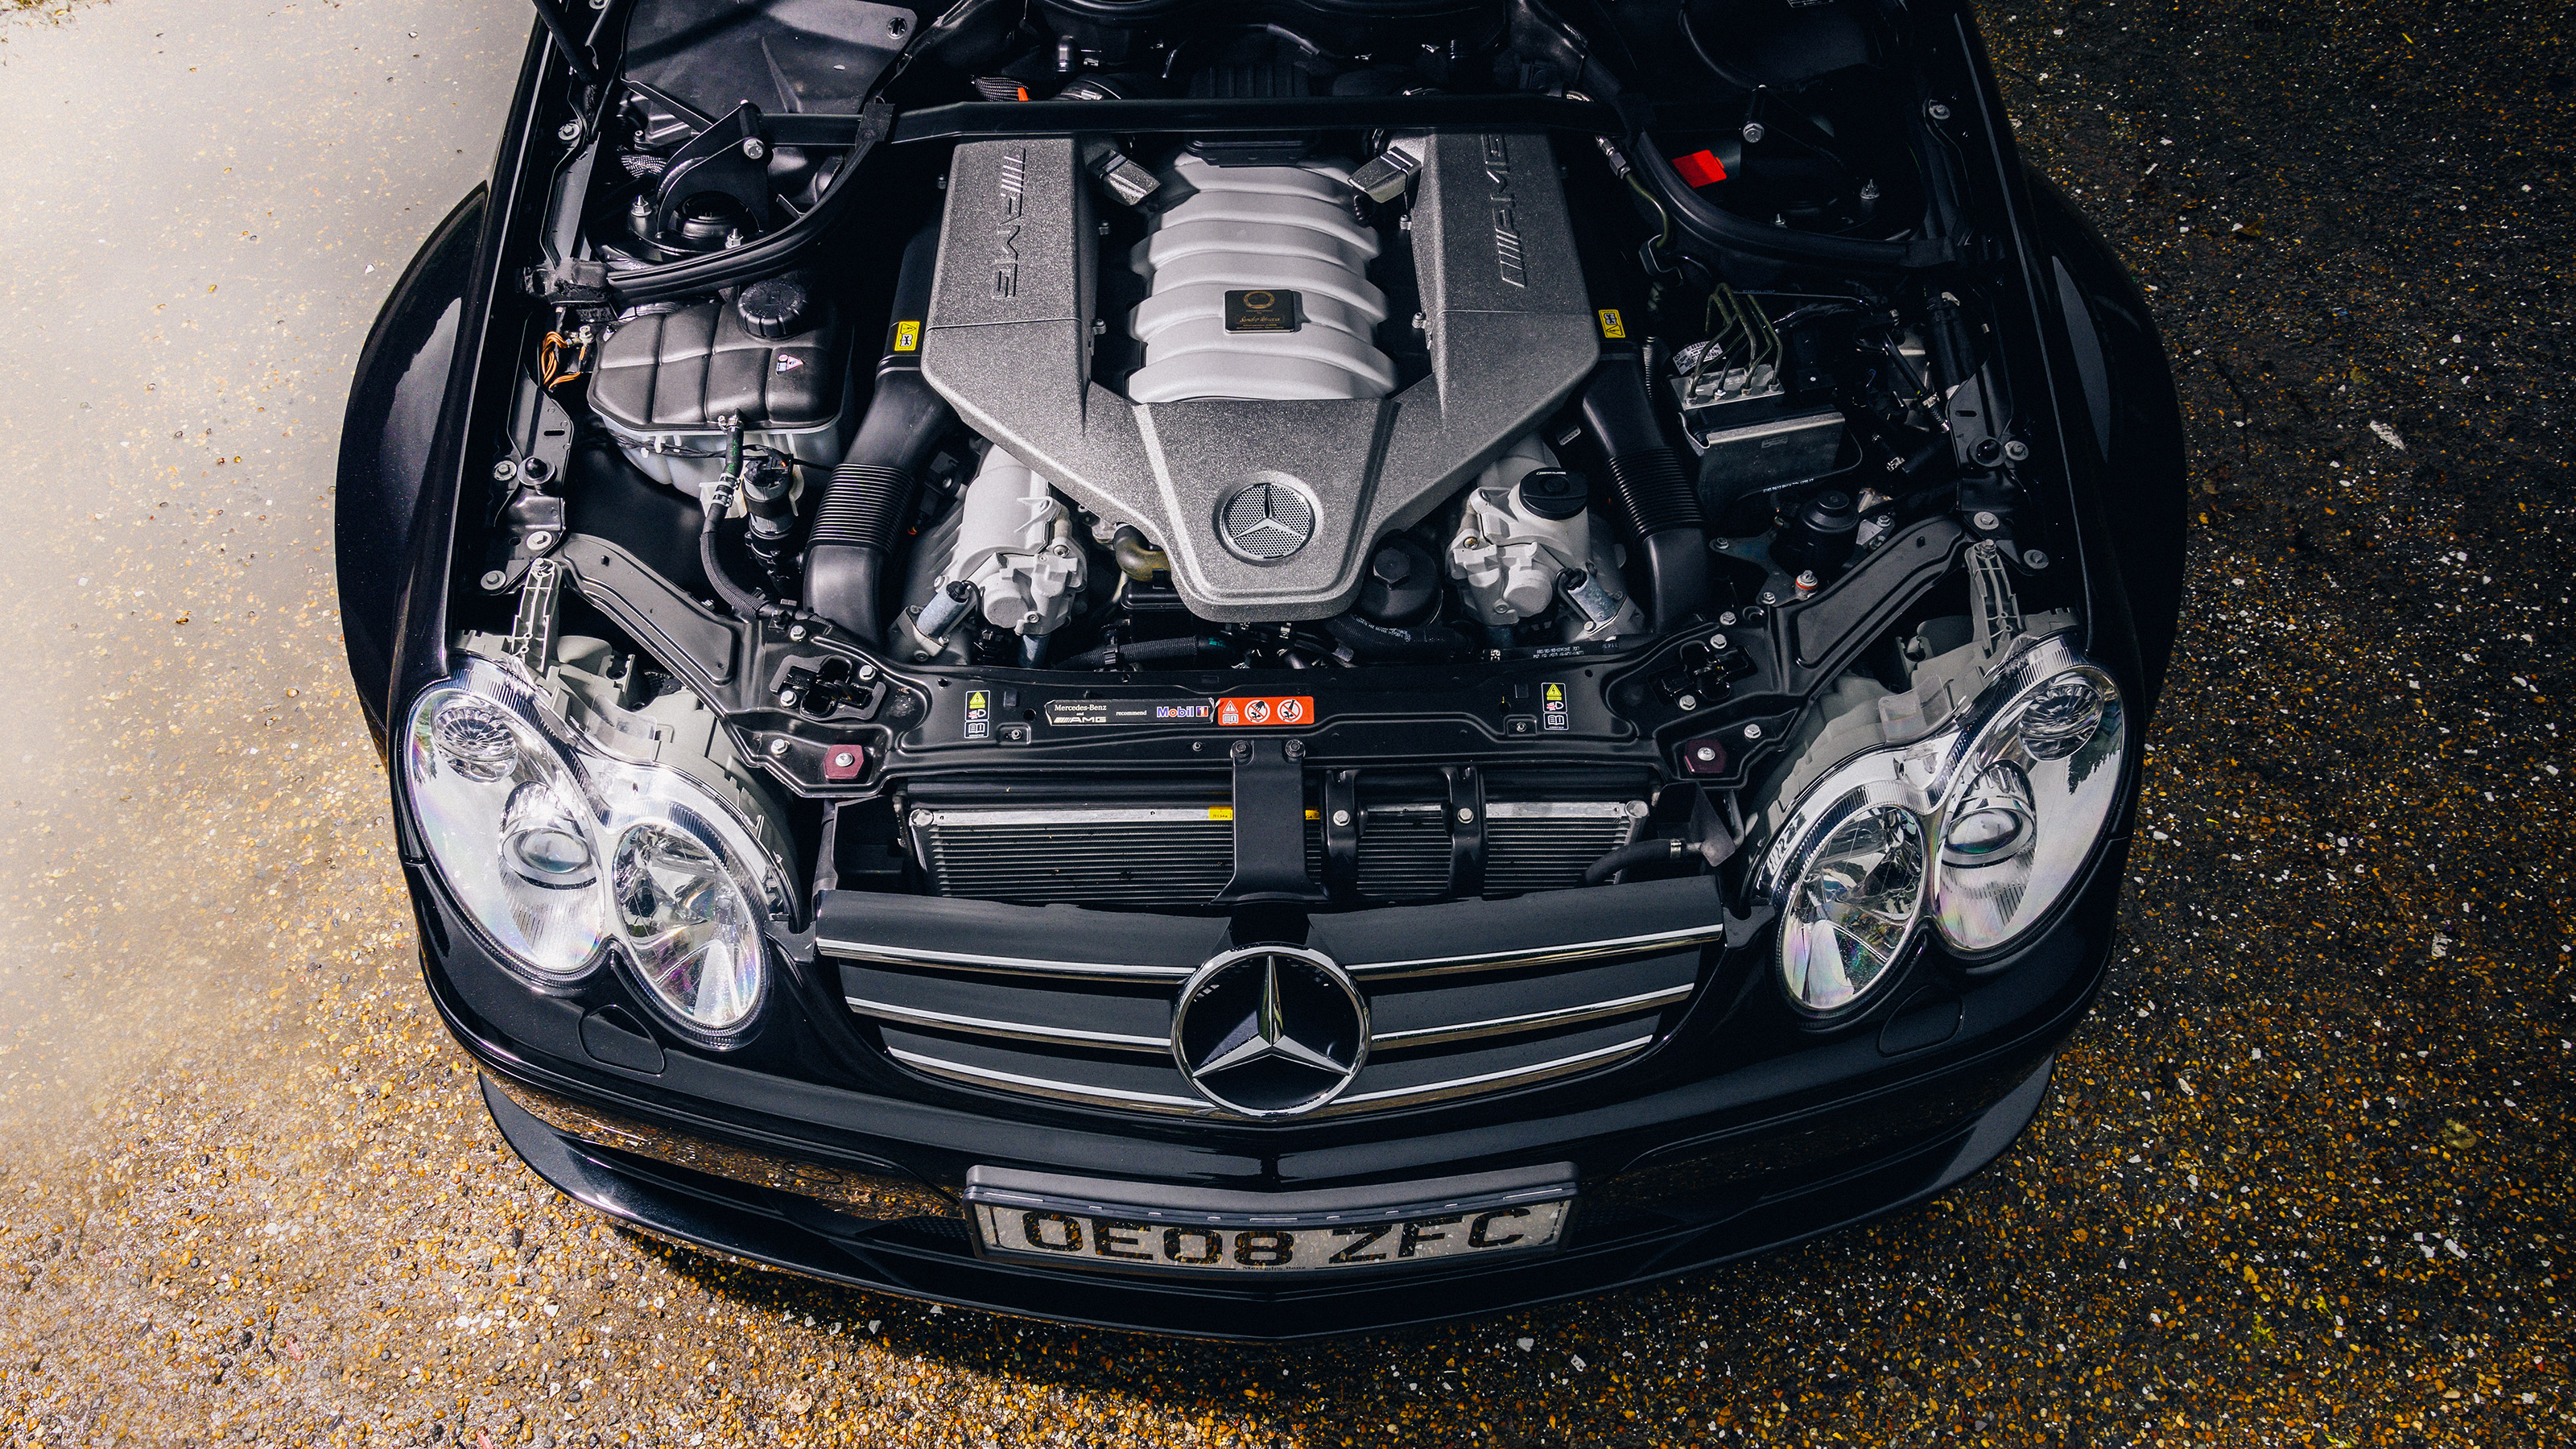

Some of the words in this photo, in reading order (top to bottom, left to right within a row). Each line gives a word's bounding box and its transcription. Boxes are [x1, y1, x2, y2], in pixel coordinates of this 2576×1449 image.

[1157, 706, 1194, 717] Mobil
[1022, 1212, 1294, 1266] OE08
[1328, 1208, 1530, 1264] ZFC
